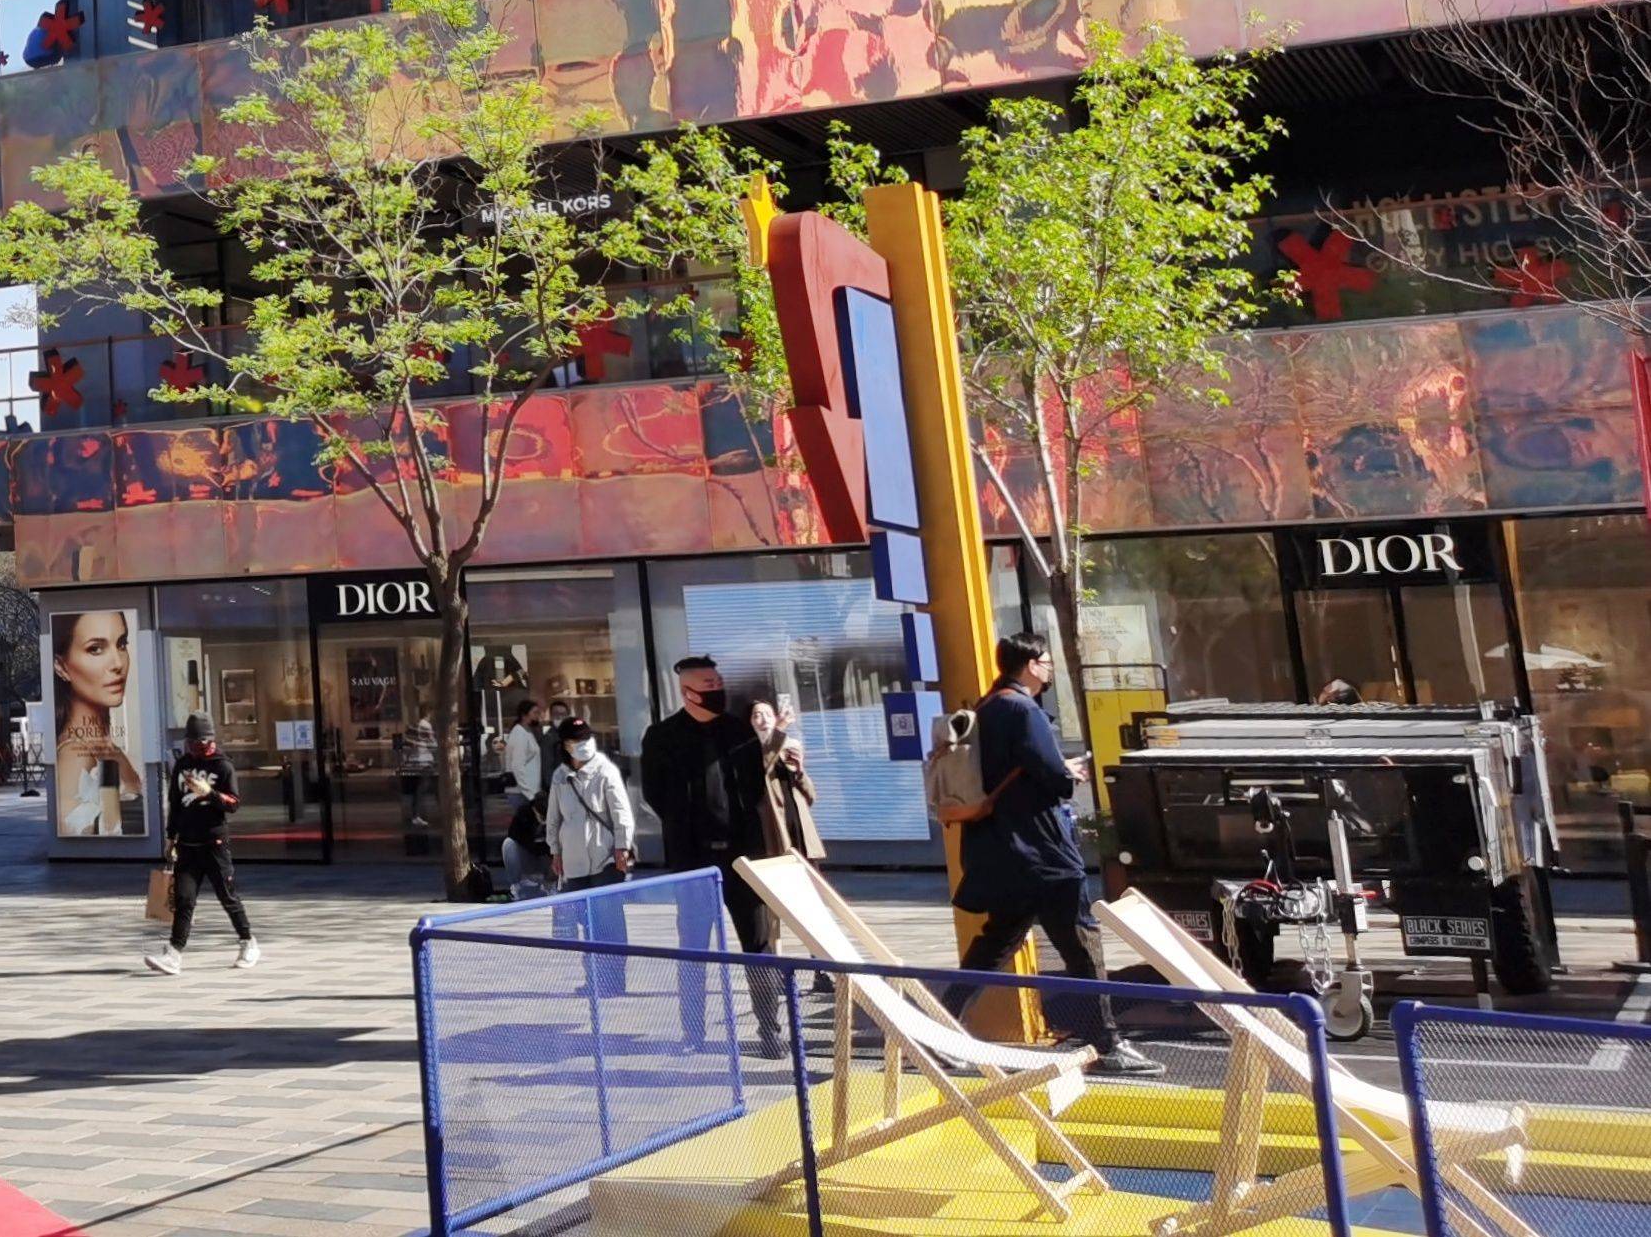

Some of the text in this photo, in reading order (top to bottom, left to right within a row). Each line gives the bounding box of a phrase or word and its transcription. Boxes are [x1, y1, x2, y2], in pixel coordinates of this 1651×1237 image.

[562, 194, 611, 213] KORS
[1318, 534, 1462, 577] DIOR
[337, 580, 435, 617] DIOR
[1406, 918, 1486, 936] BLACK SERIES
